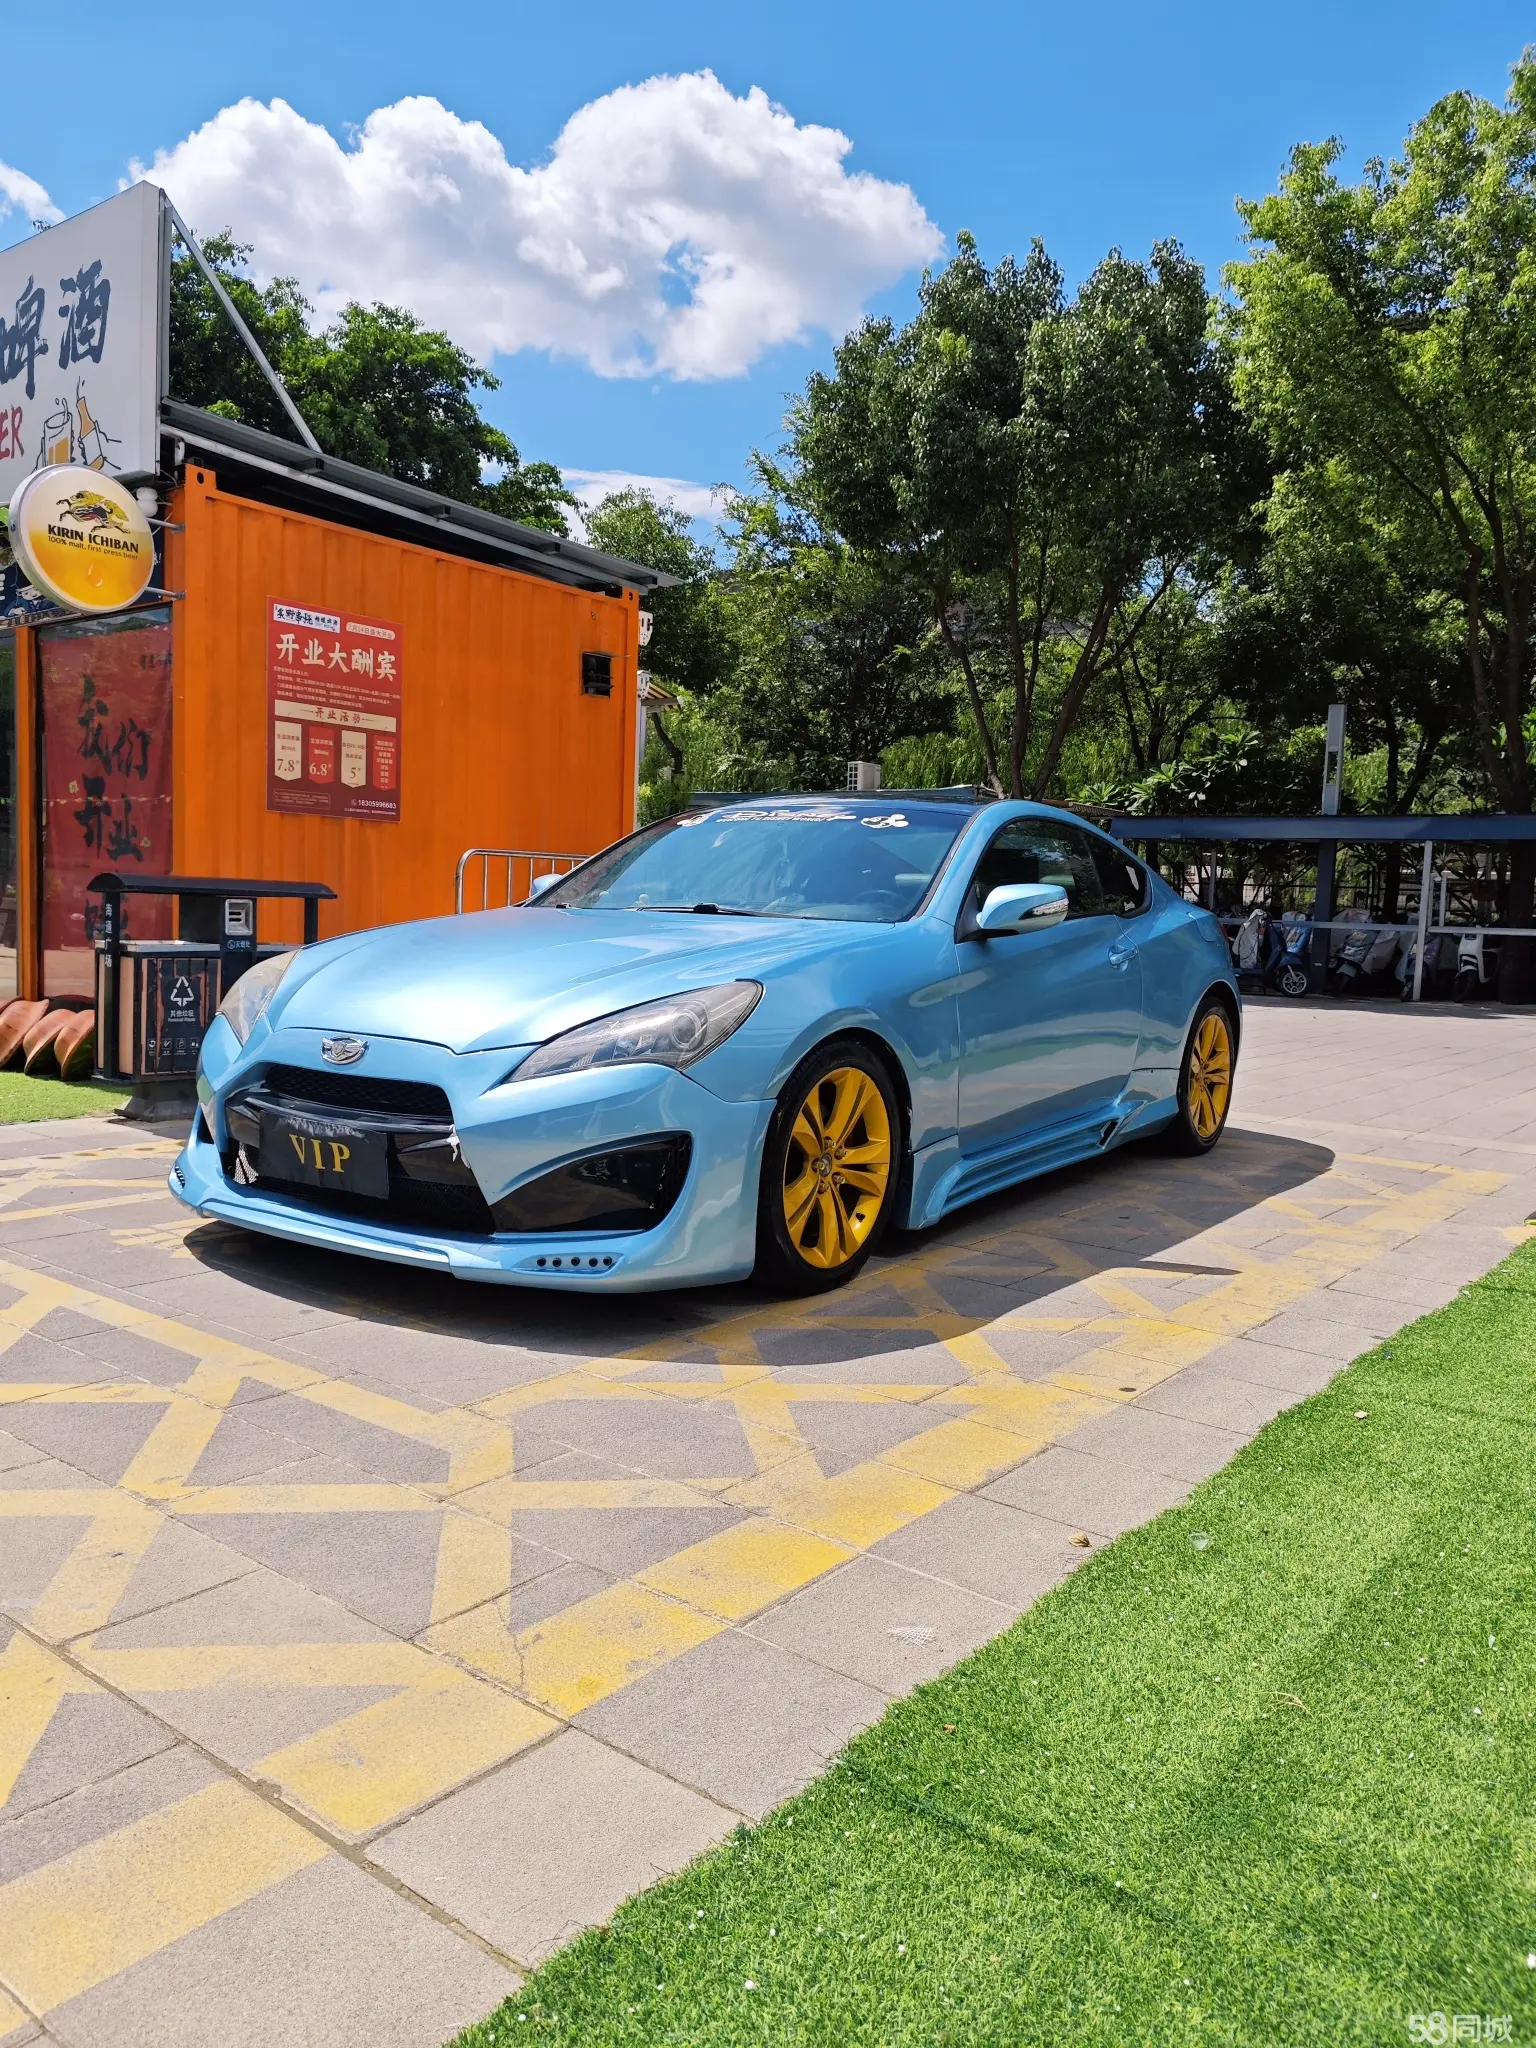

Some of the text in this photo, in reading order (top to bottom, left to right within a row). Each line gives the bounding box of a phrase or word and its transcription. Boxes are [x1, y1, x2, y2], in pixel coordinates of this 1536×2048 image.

[0, 259, 110, 400] 啤酒
[48, 524, 139, 554] KIRIN ICHIBAN
[48, 535, 139, 560] 100% malt, first press beer
[275, 633, 397, 682] 开业大酬宾
[77, 673, 152, 781] 我们
[315, 707, 361, 724] 开业活动
[74, 774, 145, 863] 开业
[170, 1009, 195, 1018] 其他垃圾
[289, 1133, 351, 1173] VIP
